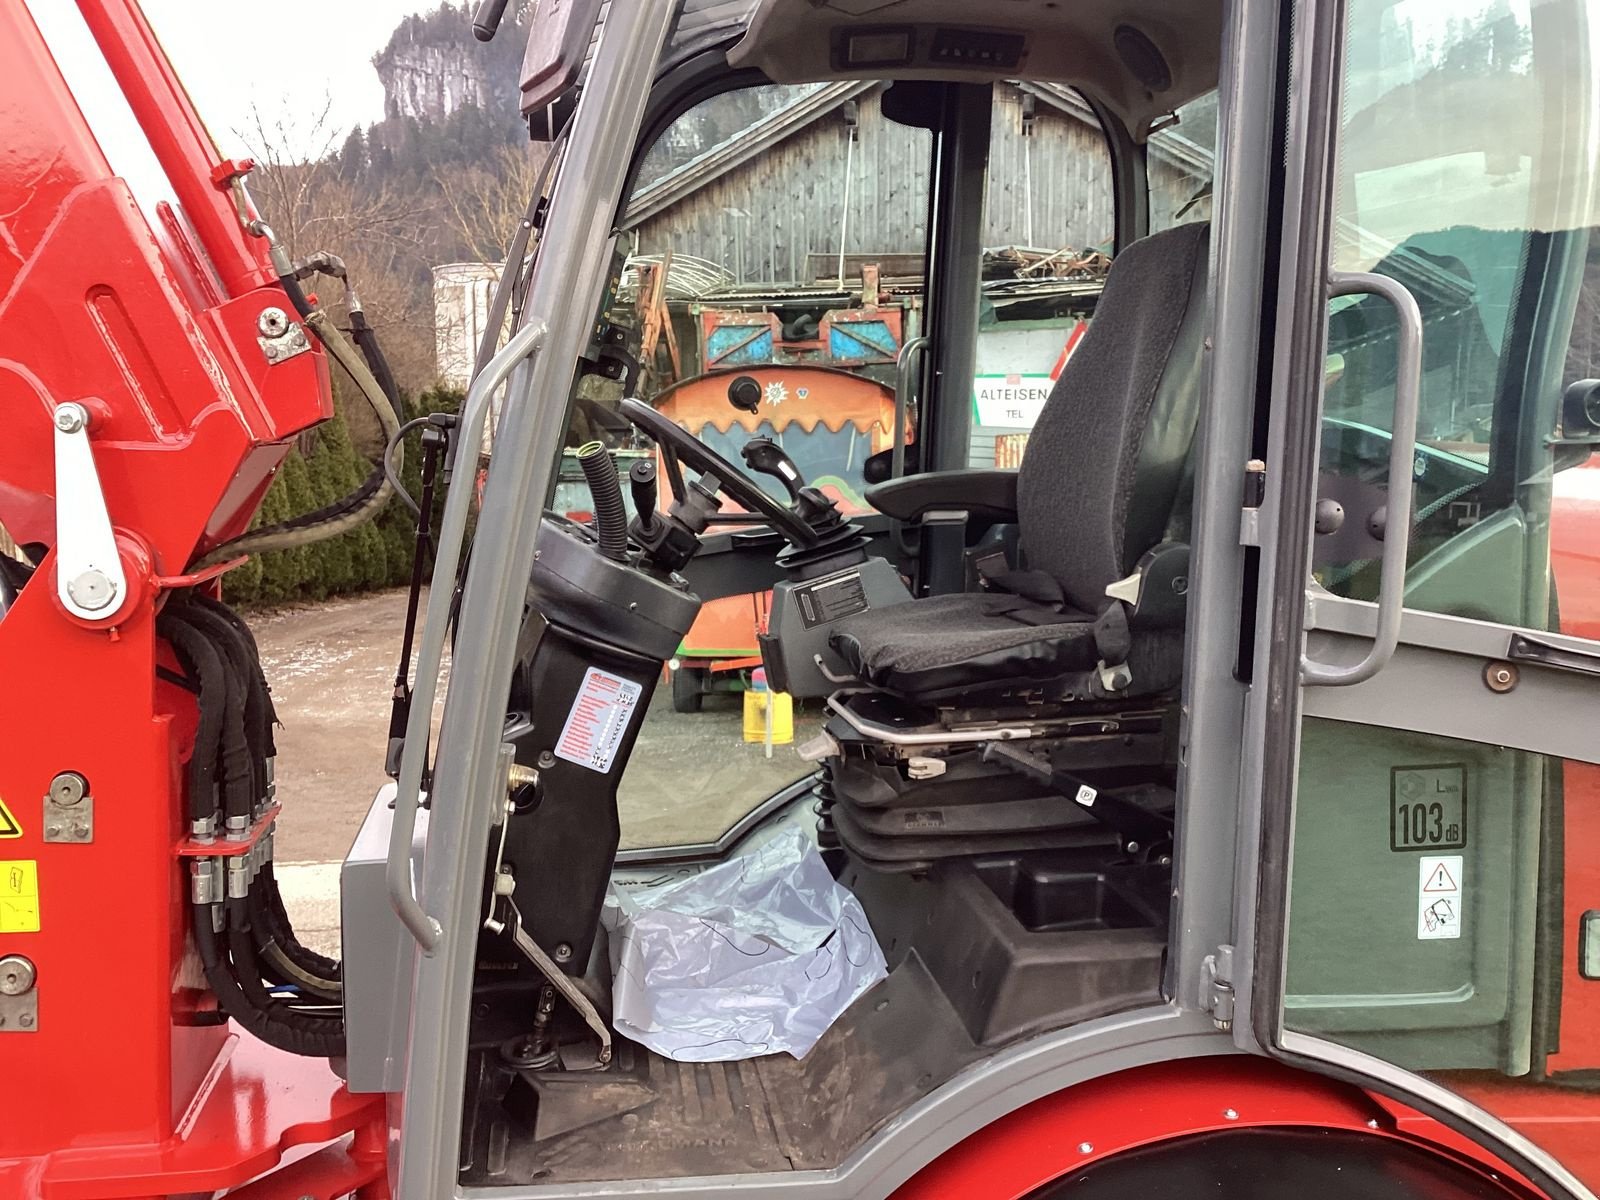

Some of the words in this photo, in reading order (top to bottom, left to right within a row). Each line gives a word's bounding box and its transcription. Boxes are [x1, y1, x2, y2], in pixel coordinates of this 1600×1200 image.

[980, 388, 1048, 401] ALTEISEN
[1006, 409, 1024, 418] TEL
[1398, 802, 1443, 845] 103
[1445, 823, 1459, 842] dB
